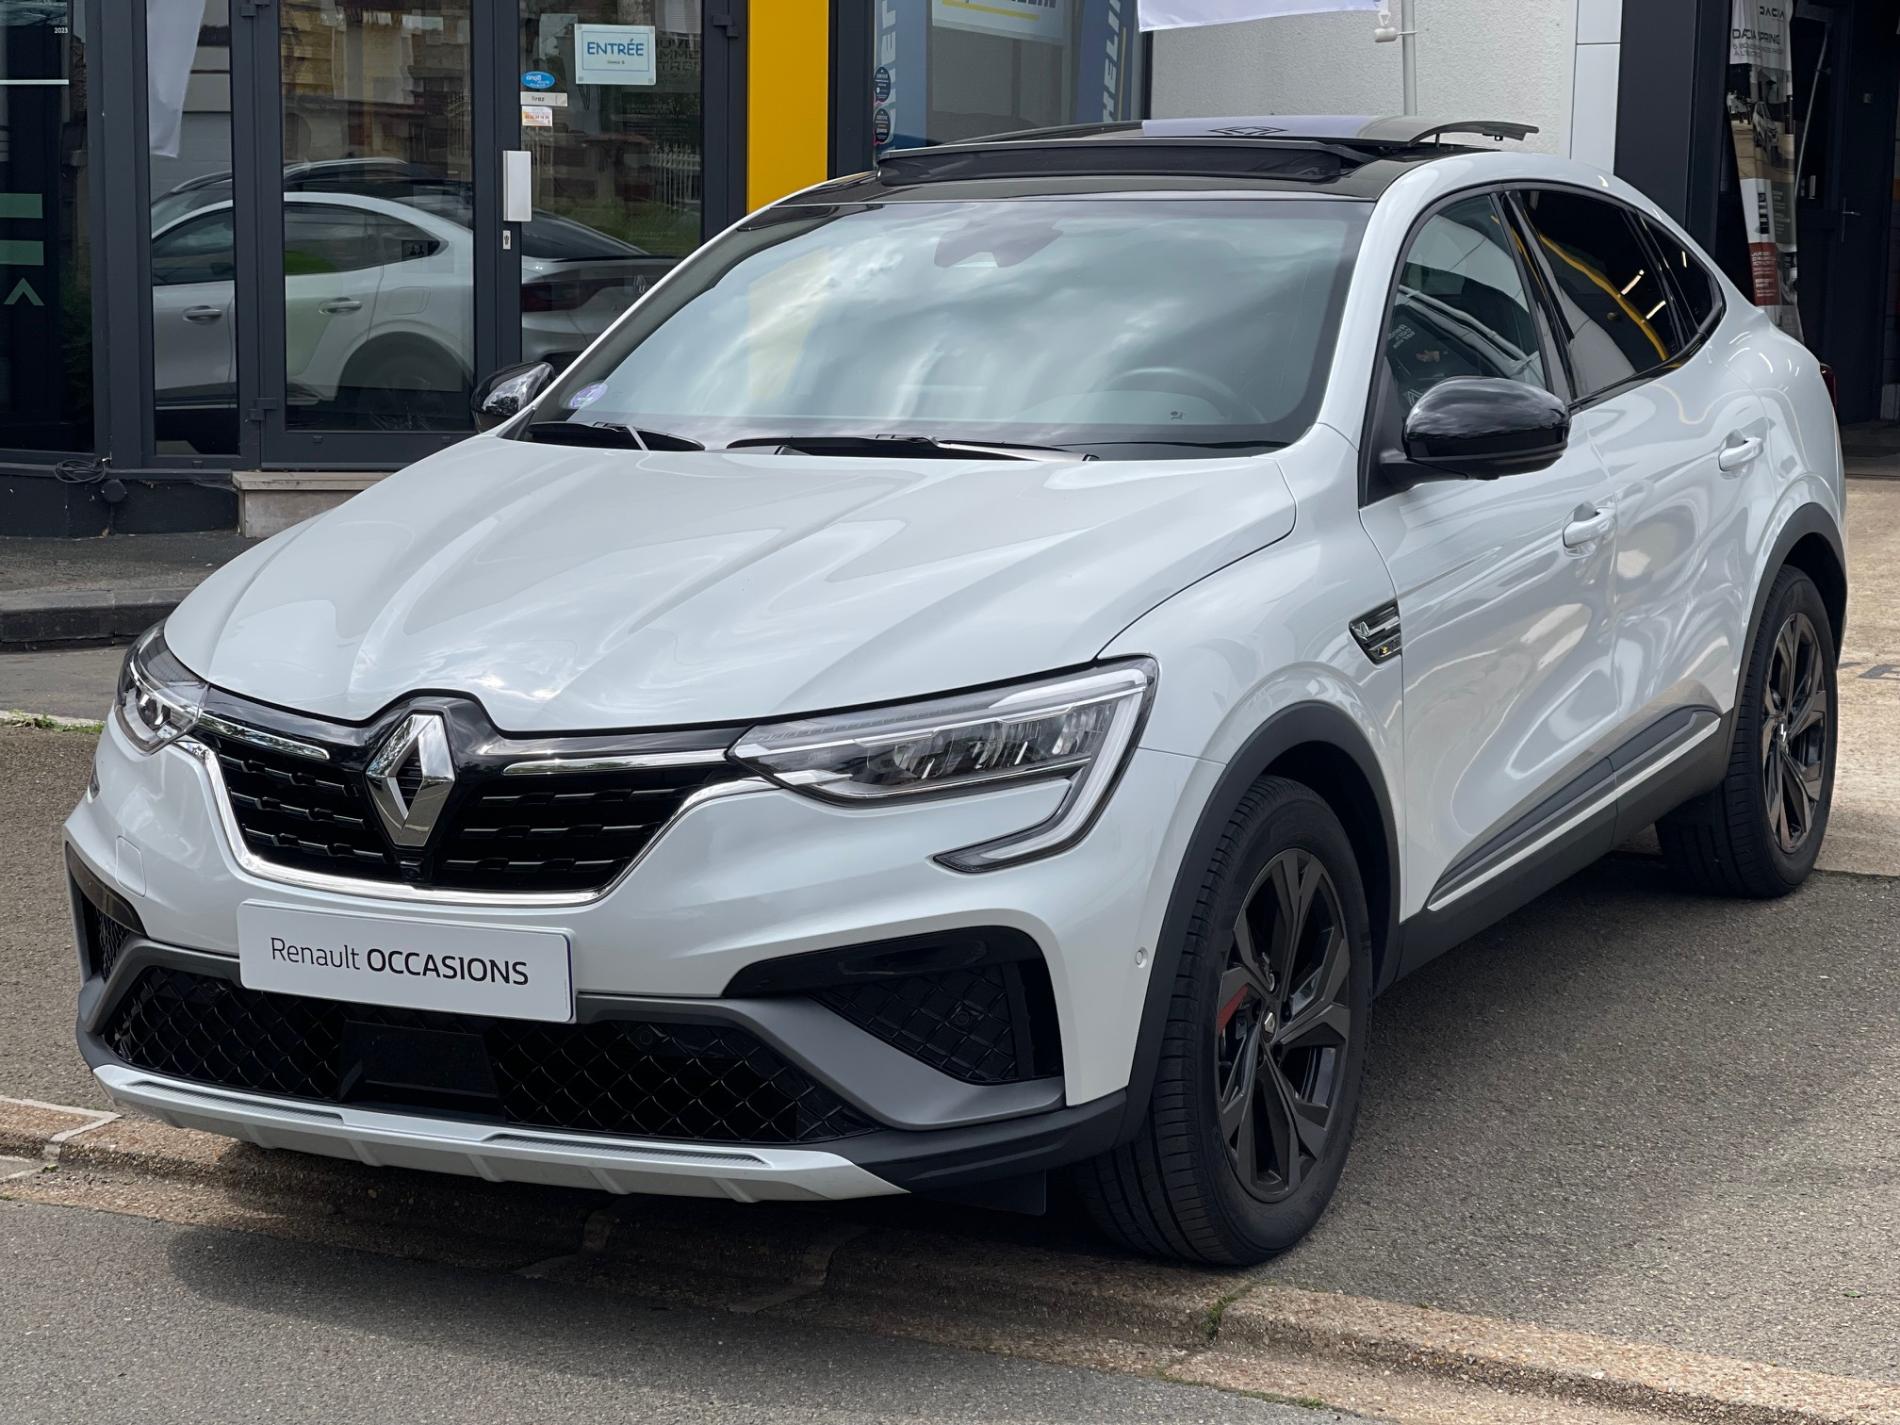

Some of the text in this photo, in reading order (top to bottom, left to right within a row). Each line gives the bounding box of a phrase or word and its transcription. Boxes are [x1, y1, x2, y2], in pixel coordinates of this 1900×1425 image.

[587, 38, 644, 56] ENTRÉE
[270, 937, 529, 986] Renault OCCASIONS
